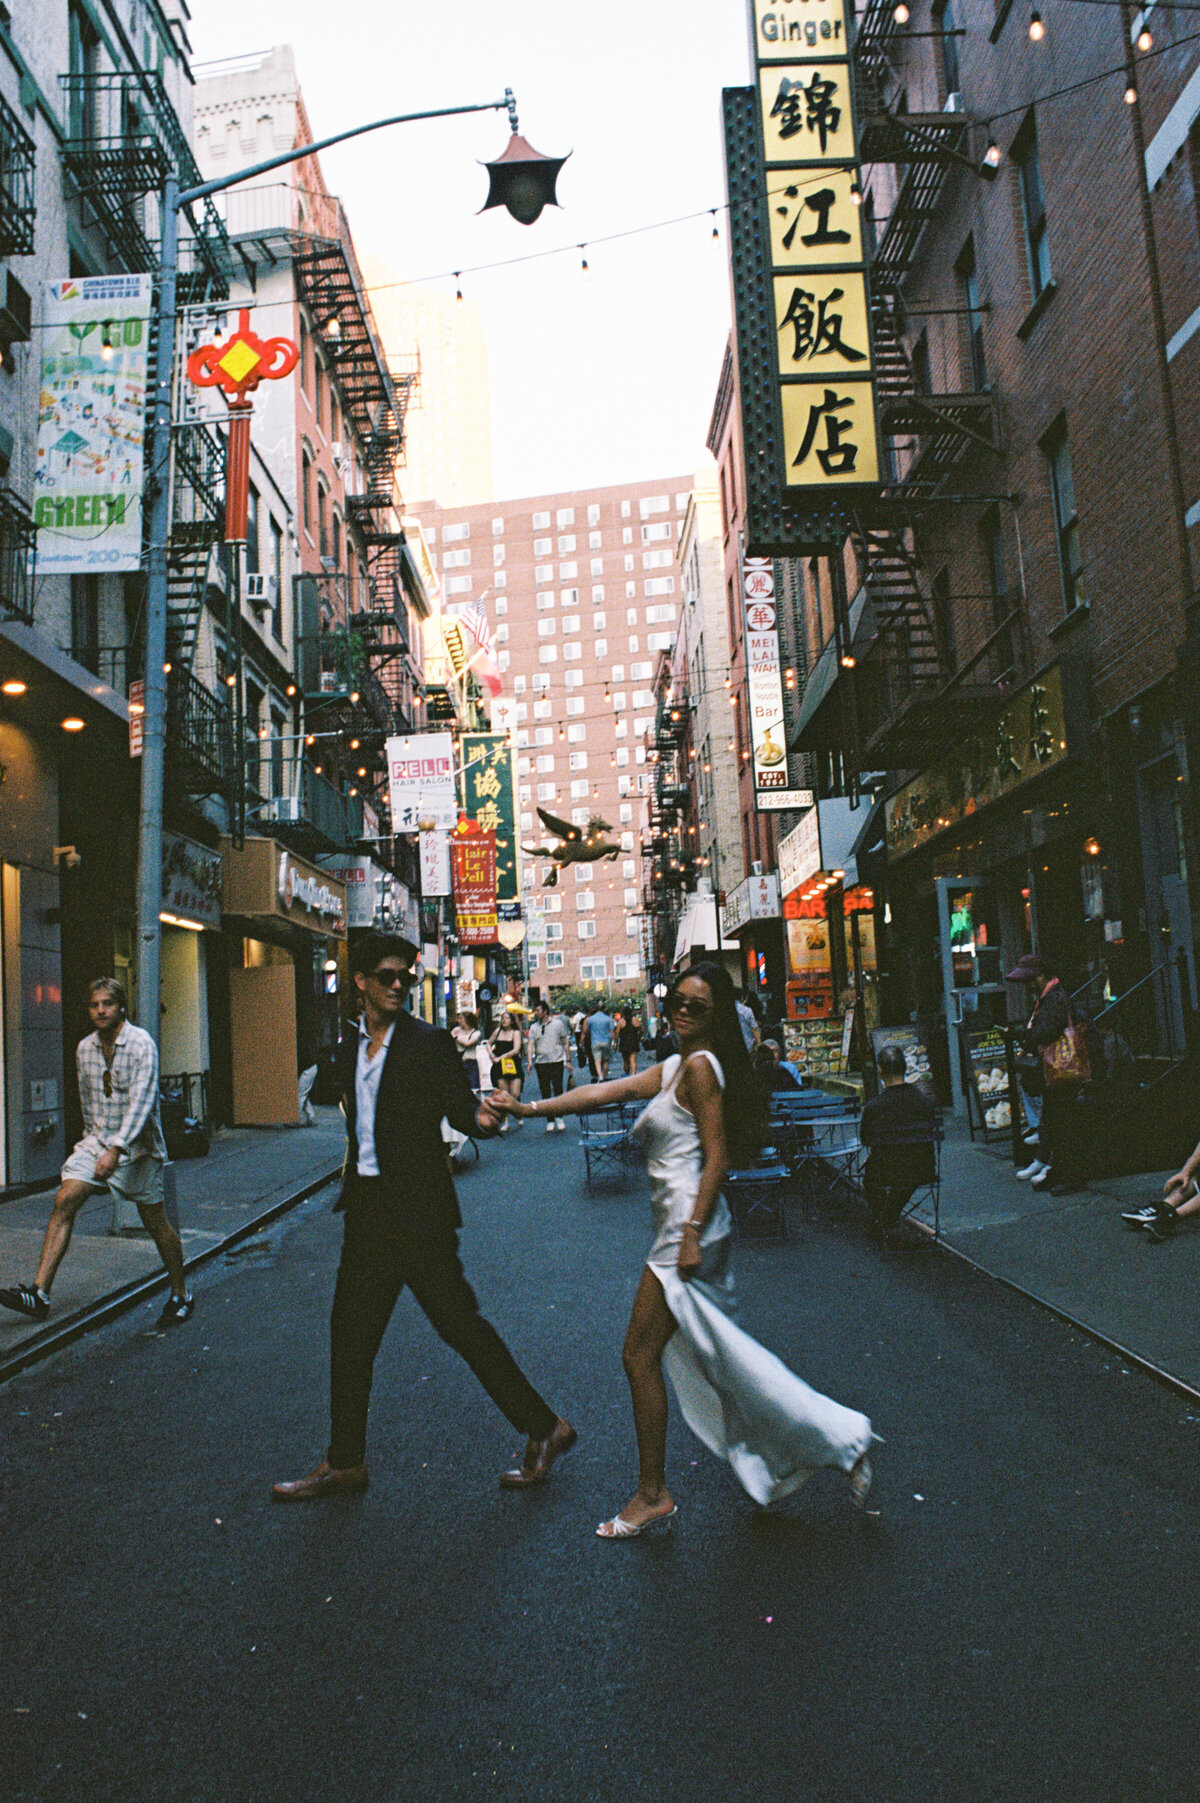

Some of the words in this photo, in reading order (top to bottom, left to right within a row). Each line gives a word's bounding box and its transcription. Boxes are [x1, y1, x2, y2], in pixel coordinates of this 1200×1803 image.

[761, 13, 842, 46] Ginger
[769, 72, 868, 477] 錦江飯店
[101, 316, 143, 348] GO
[35, 493, 126, 528] GREEN
[87, 549, 121, 563] 200
[751, 638, 775, 649] MEI
[753, 651, 774, 661] LAI
[751, 663, 777, 673] WAH
[755, 706, 779, 718] Bar
[393, 758, 450, 779] PELL
[420, 777, 452, 785] SALON
[465, 860, 480, 871] Le
[783, 899, 826, 919] BAR
